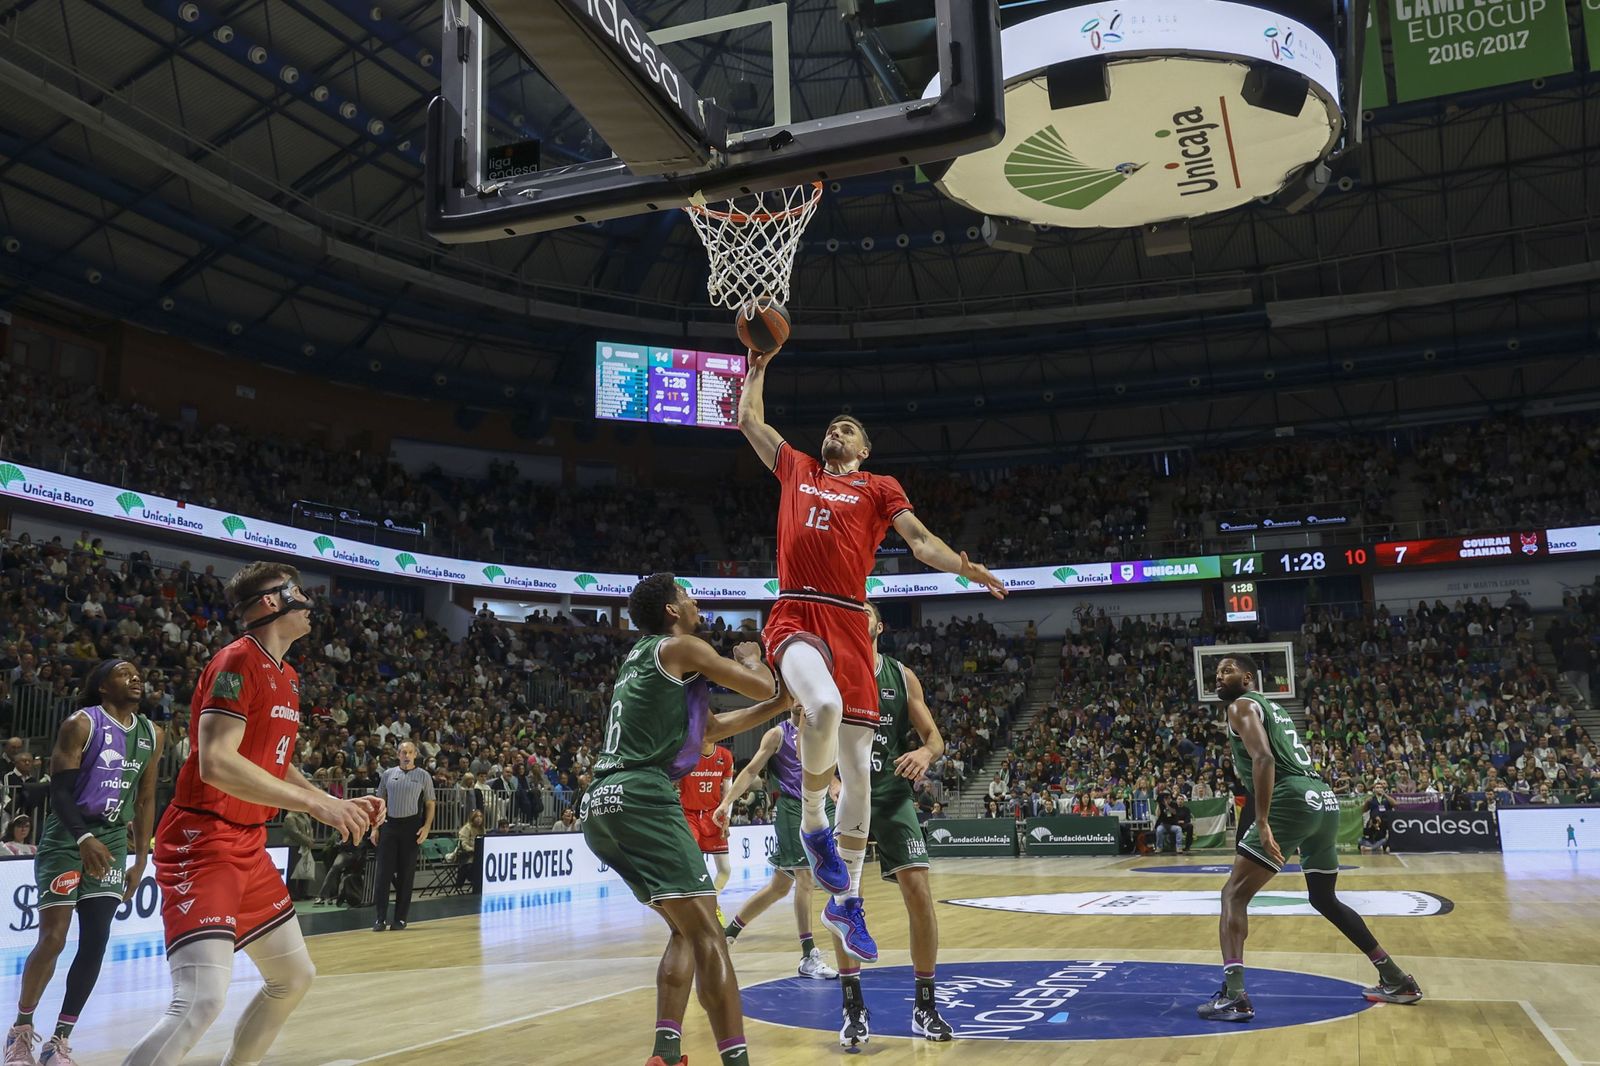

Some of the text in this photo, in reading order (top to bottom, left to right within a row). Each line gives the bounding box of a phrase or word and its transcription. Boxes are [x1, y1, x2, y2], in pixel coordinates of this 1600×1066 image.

[1408, 0, 1546, 43] EUROCUP
[1428, 30, 1530, 65] 2016/2017
[587, 0, 682, 109] desa
[1155, 106, 1219, 196] Unicaja
[489, 158, 511, 170] liga
[489, 164, 538, 181] endesa
[656, 352, 668, 362] 14
[682, 354, 689, 364] 7
[663, 377, 686, 389] 1:28
[22, 482, 94, 507] Unicaja Banco
[142, 509, 204, 530] Unicaja Banco
[805, 506, 831, 531] 12
[244, 531, 297, 550] Unicaja Banco
[1463, 536, 1511, 548] COVIRAN
[1547, 541, 1577, 549] Banco
[332, 550, 380, 567] Unicaja Banco
[1344, 549, 1366, 565] 10
[1394, 546, 1407, 564] 7
[1460, 546, 1512, 558] GRANADA
[1232, 557, 1255, 575] 14
[1280, 551, 1326, 573] 1:28
[415, 565, 466, 580] Unicaja Banco
[1143, 563, 1199, 576] UNICAJA
[503, 576, 557, 588] Unicaja Banco
[1010, 579, 1036, 587] Banco
[1077, 574, 1109, 583] Unicaja
[596, 584, 625, 594] Unicaja
[691, 587, 747, 597] Unicaja Banco
[882, 584, 938, 594] Unicaja Banco
[1231, 583, 1254, 593] 1:28
[1229, 596, 1253, 612] 10
[880, 713, 893, 725] caja
[1284, 729, 1311, 766] 3
[592, 784, 624, 798] COSTA
[699, 781, 713, 793] 32
[590, 795, 623, 808] DEL SOL
[591, 805, 624, 817] MÁLAGA
[1391, 814, 1489, 835] endesa
[485, 848, 573, 882] QUE HOTELS
[199, 916, 221, 924] vive
